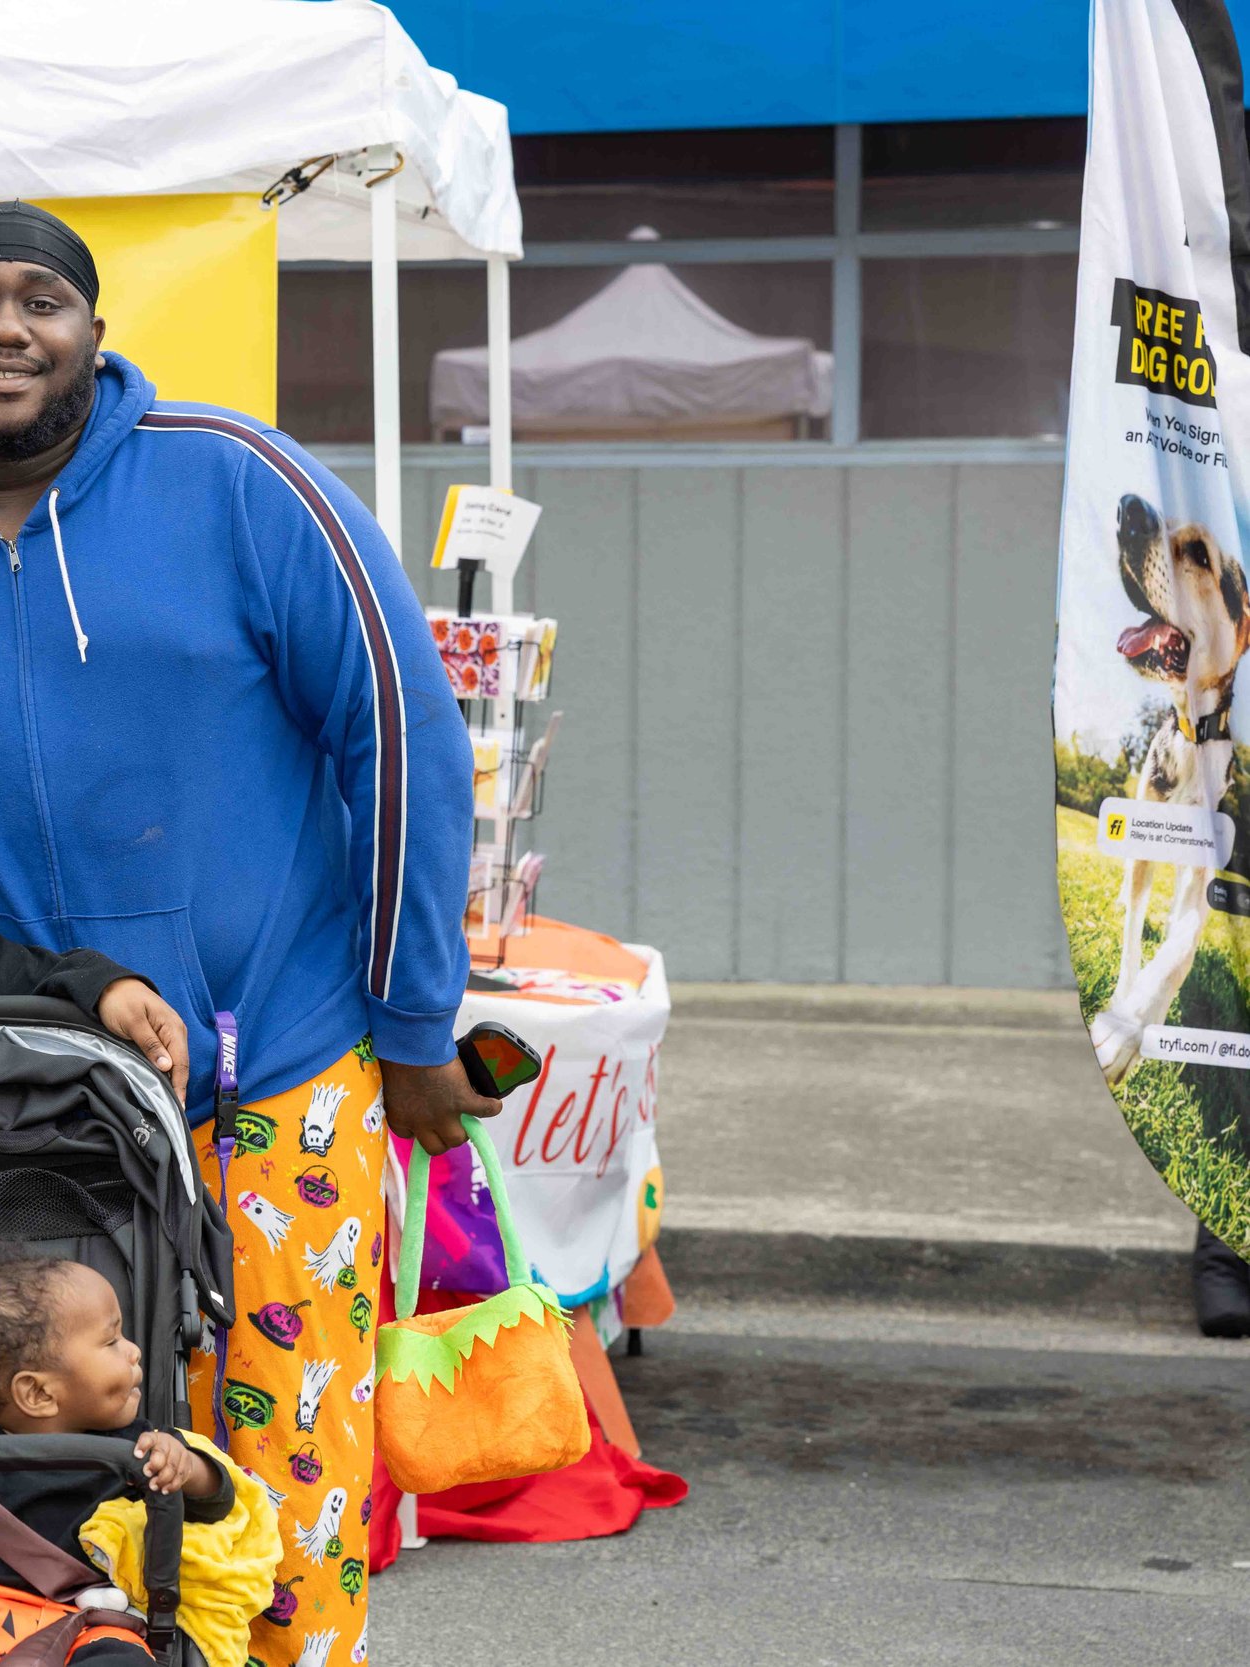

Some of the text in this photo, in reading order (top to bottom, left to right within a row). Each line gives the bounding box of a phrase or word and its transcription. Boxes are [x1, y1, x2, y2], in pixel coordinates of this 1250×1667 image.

[1165, 415, 1187, 435] You
[1189, 425, 1220, 445] Sign
[1125, 430, 1143, 443] an
[1160, 437, 1193, 460] Voice
[1195, 452, 1210, 465] or
[1130, 831, 1147, 841] Riley
[1149, 833, 1155, 841] is
[1156, 834, 1162, 842] at
[1132, 818, 1193, 834] Location Update
[1160, 1038, 1209, 1053] tryfi.com
[513, 1044, 628, 1179] let's
